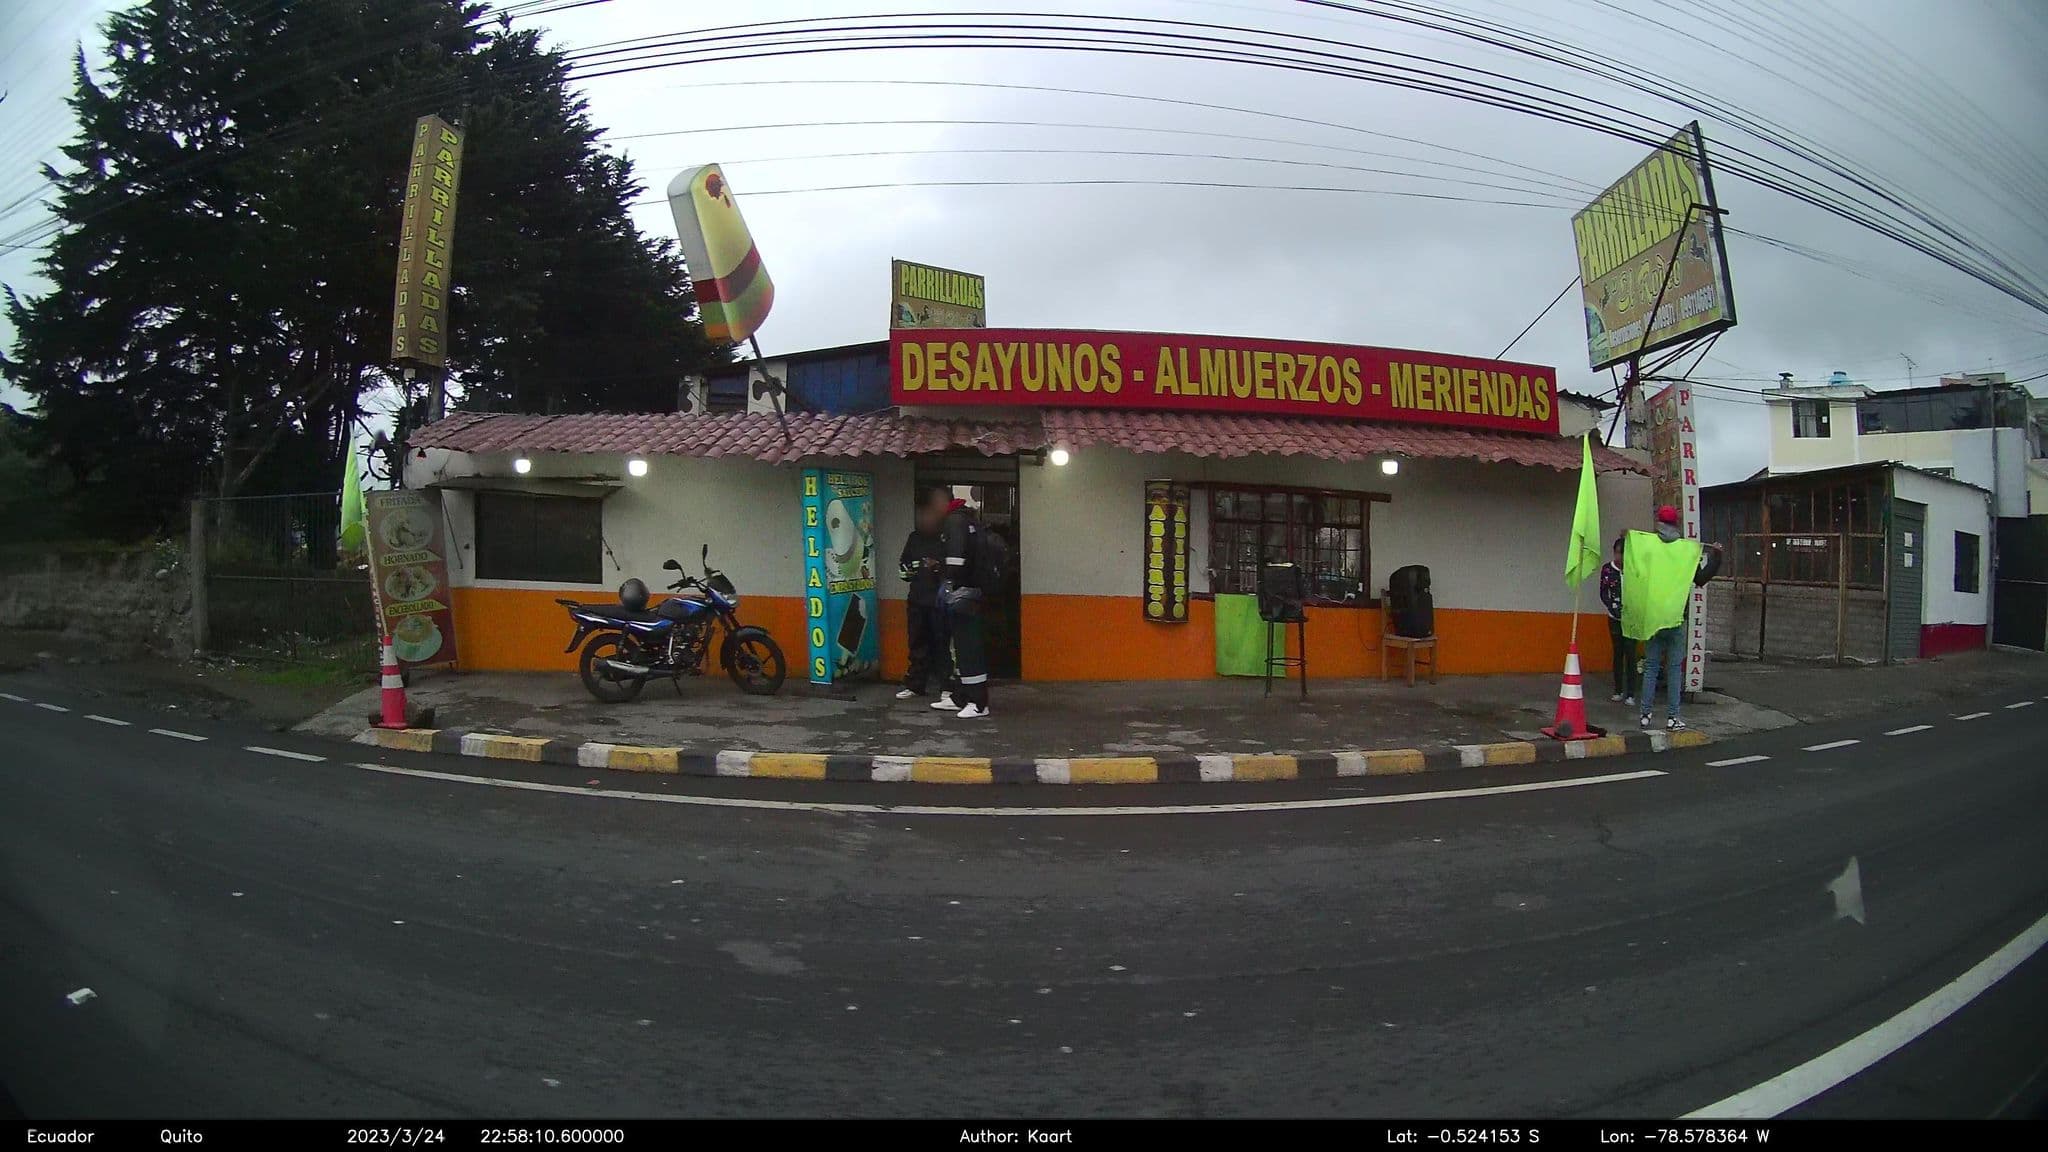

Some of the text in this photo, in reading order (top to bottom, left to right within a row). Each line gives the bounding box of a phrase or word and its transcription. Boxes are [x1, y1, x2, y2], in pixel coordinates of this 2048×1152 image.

[396, 123, 430, 353] PARRILLADAS
[419, 126, 460, 355] PARRILLADAS
[1574, 134, 1701, 286] PARRILLADAS
[901, 263, 984, 310] PARRILLADAS
[903, 342, 1122, 393] DESAYUNOS
[1155, 347, 1363, 405] ALMUERZOS
[1390, 361, 1550, 422] MERIENDAS
[384, 551, 428, 566] HORNADO
[389, 600, 435, 616] ENCEBOLLADO
[805, 476, 826, 678] HELADOS
